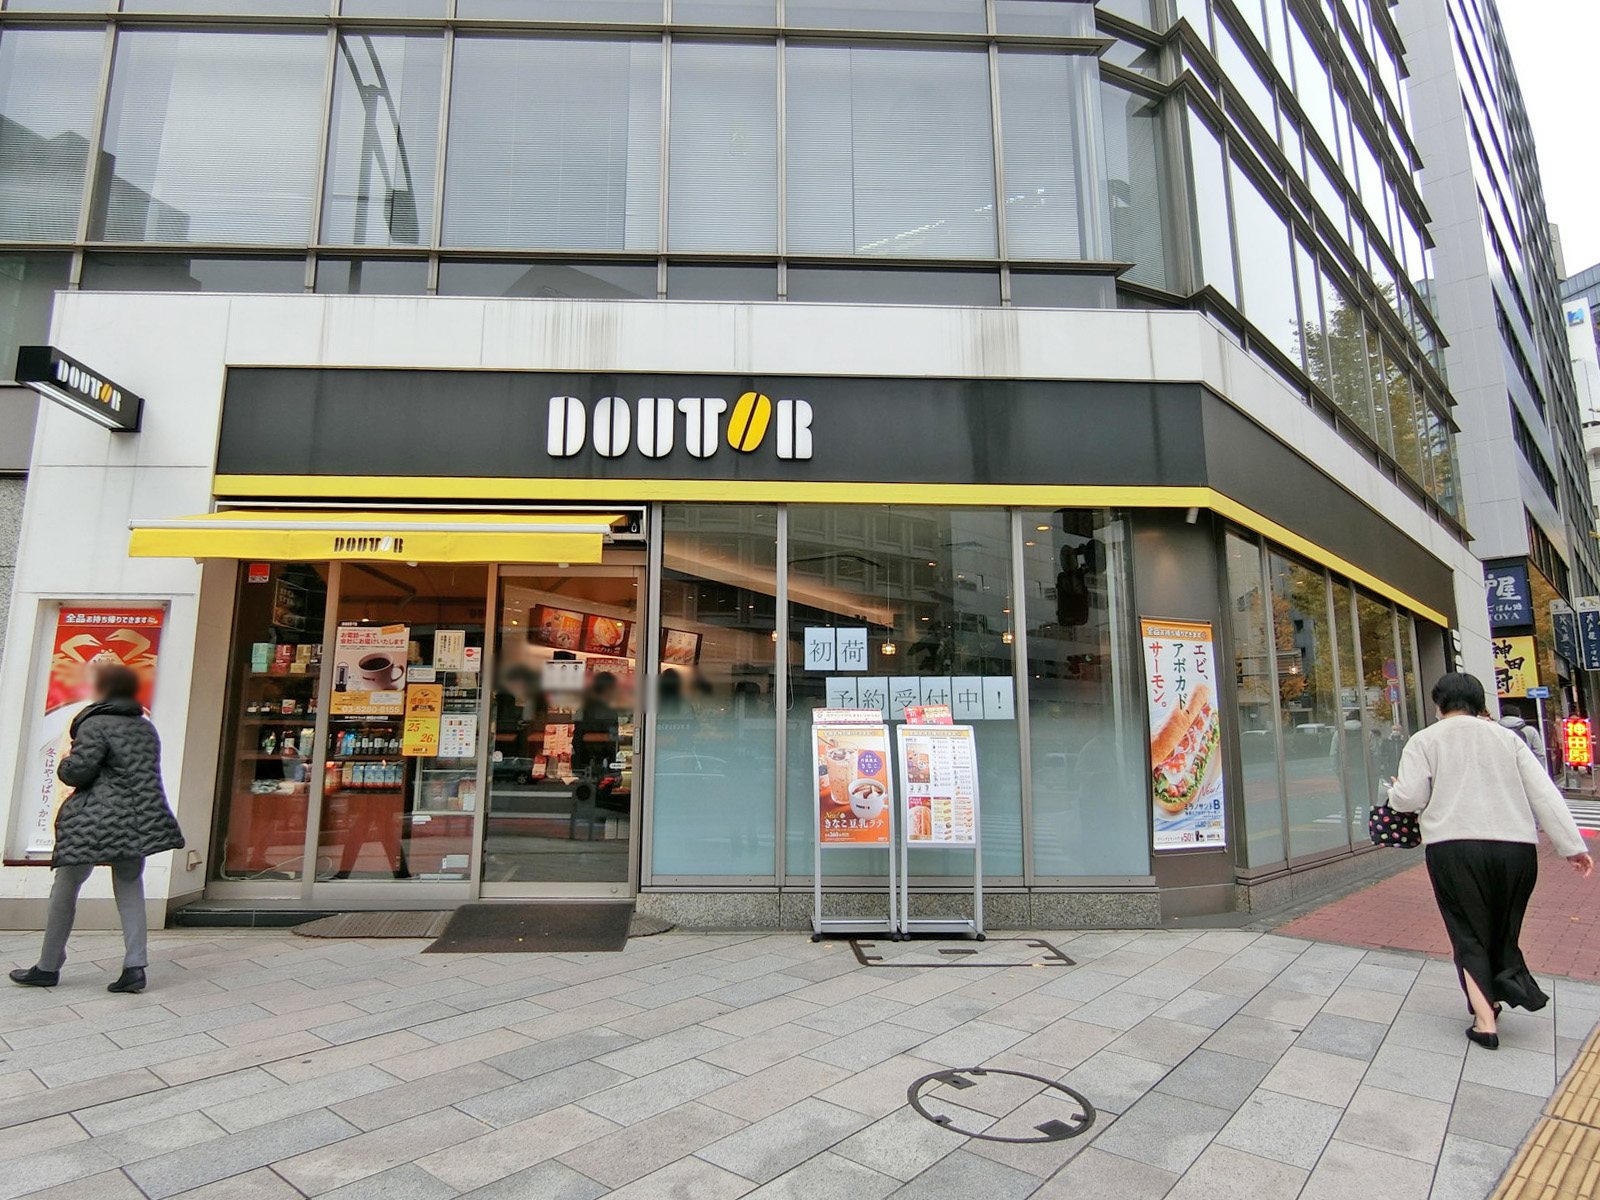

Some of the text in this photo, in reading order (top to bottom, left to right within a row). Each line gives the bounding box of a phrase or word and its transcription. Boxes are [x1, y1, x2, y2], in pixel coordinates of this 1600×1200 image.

[56, 358, 122, 412] DOUTOR
[547, 391, 813, 460] DOUTOR
[334, 536, 404, 553] DOUTOR
[809, 639, 864, 663] 初荷
[1193, 644, 1209, 680] エビ、
[1148, 641, 1167, 708] サーモン。
[1172, 643, 1190, 715] アボカド、
[407, 722, 421, 732] 25
[1567, 722, 1588, 763] 神田厨
